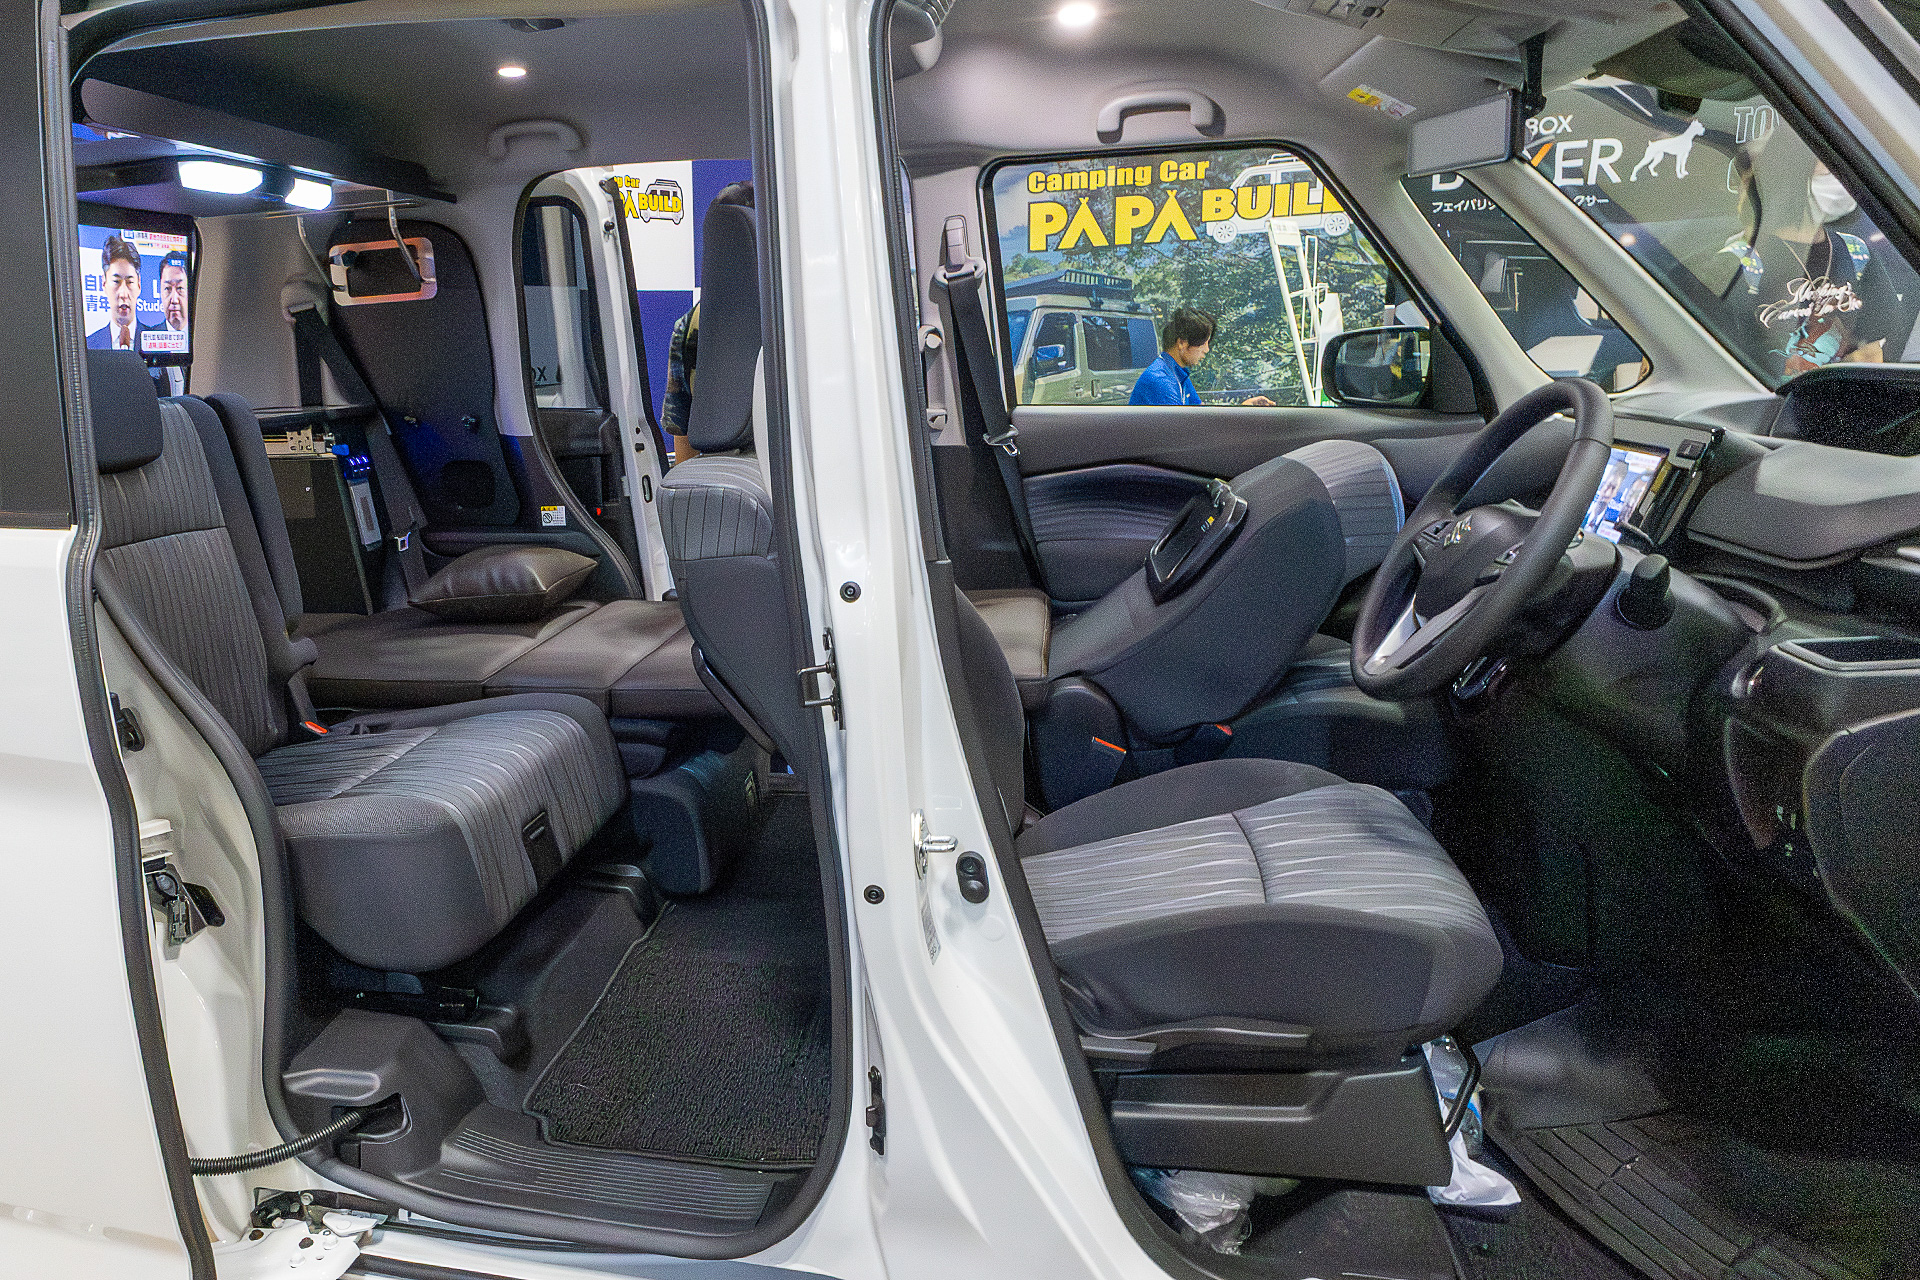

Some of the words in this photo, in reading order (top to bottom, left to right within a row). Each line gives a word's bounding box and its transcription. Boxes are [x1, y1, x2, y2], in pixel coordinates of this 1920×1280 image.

[624, 175, 640, 188] Car
[1027, 164, 1153, 194] Camping
[1158, 159, 1210, 184] Car
[638, 193, 682, 213] BUILD
[85, 274, 104, 291] 自
[137, 298, 164, 312] Stude
